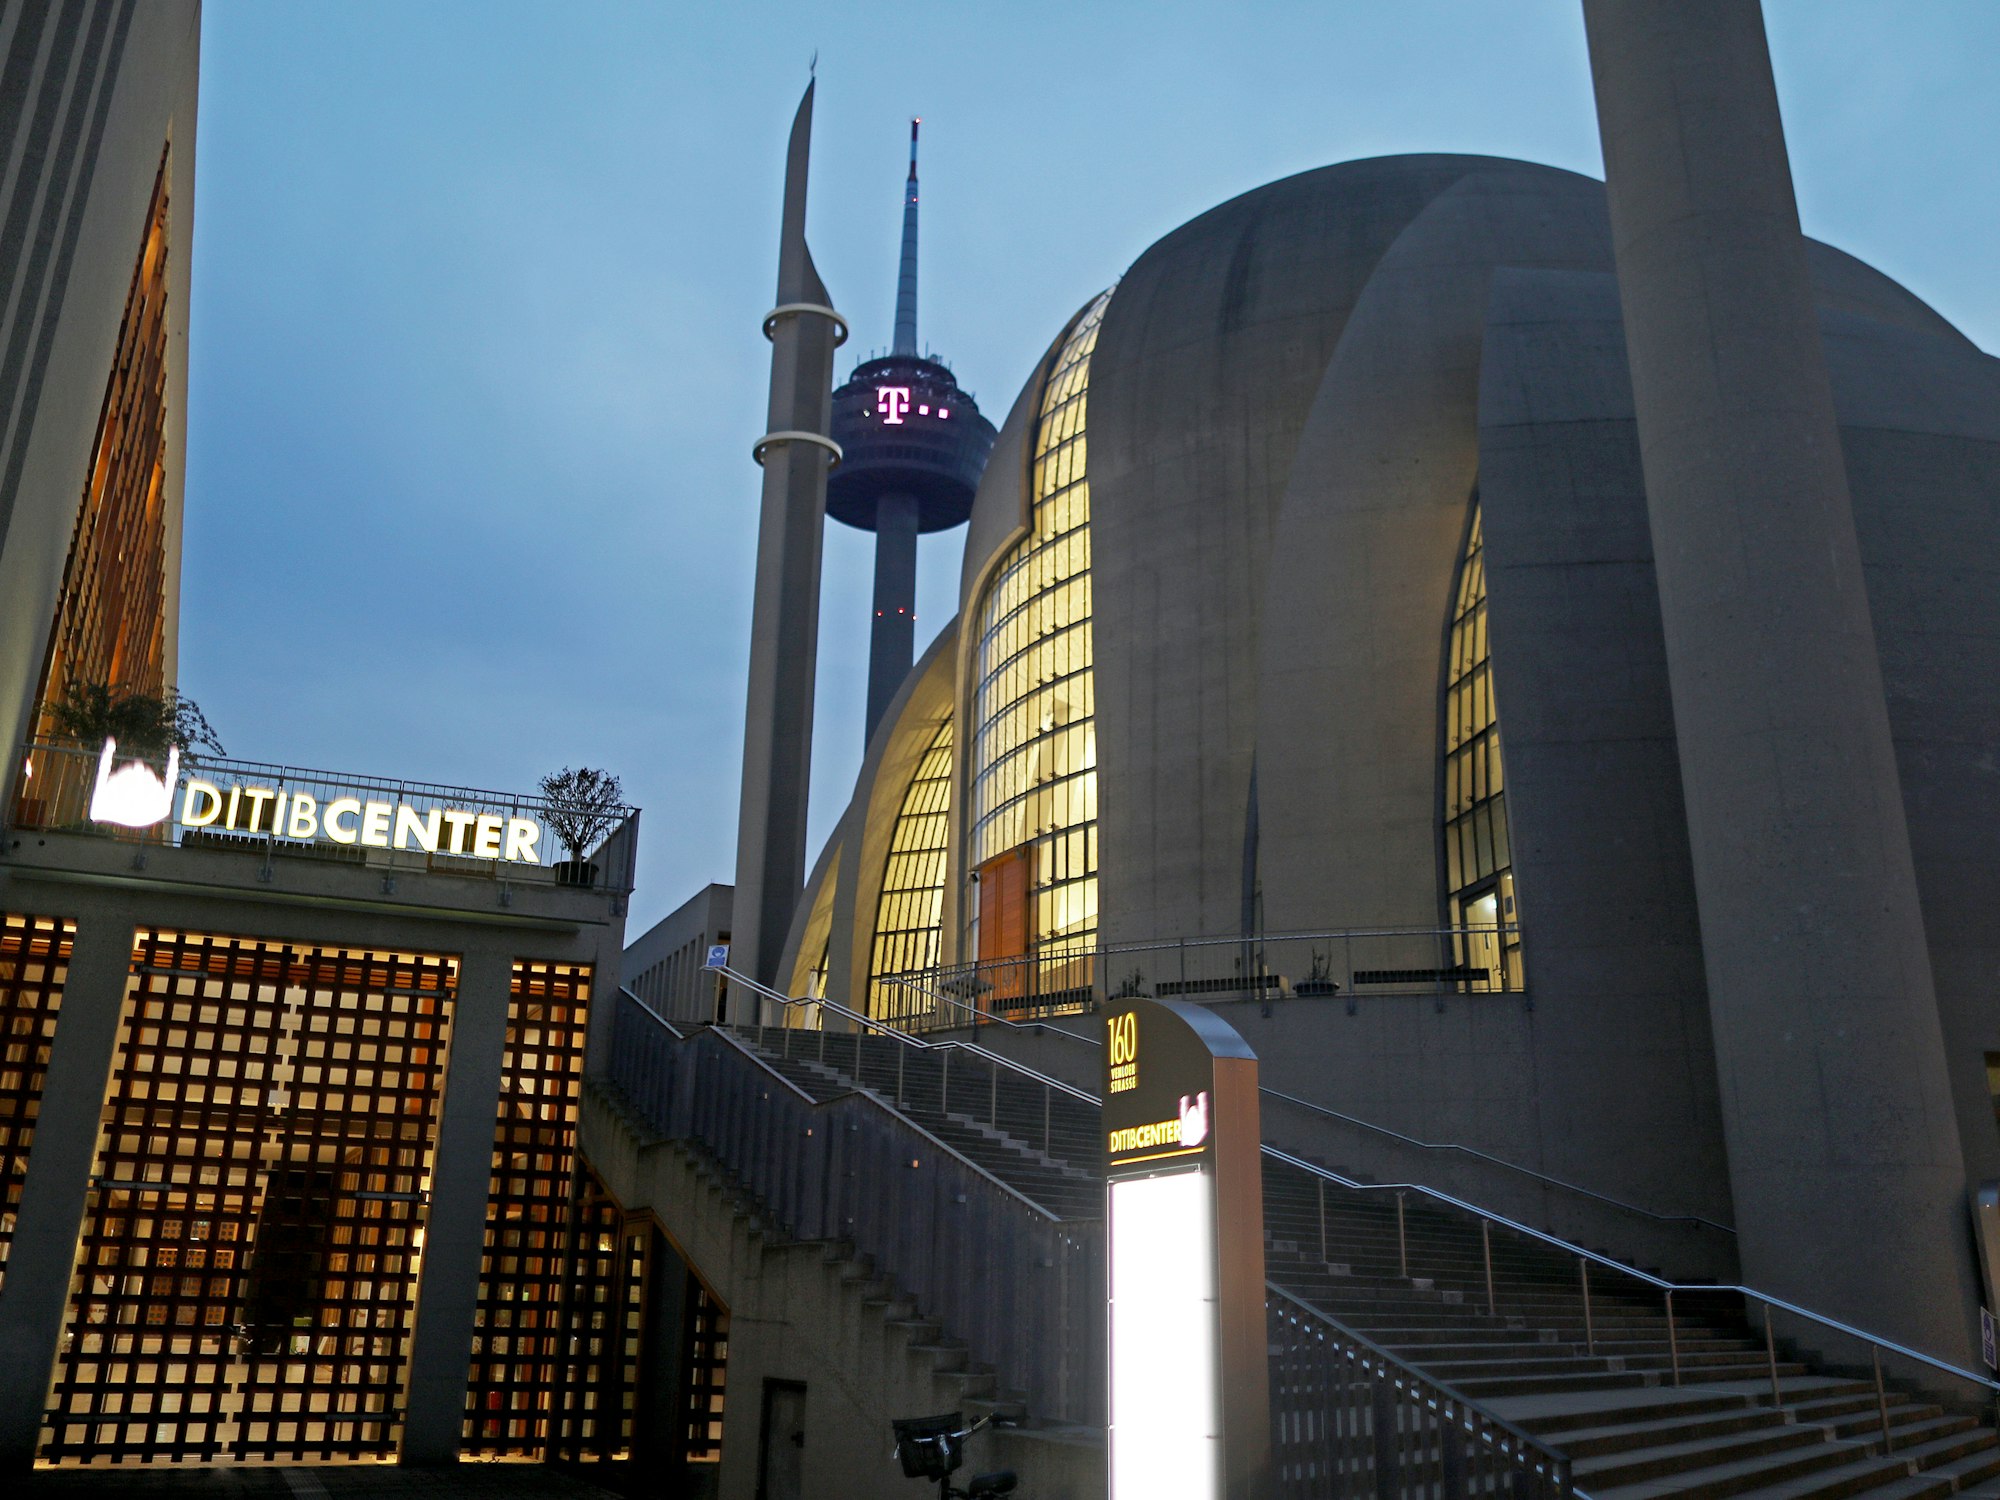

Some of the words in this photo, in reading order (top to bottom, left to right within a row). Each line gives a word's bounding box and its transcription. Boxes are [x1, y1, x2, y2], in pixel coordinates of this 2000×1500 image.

[181, 781, 540, 863] DITIBCENTER
[1107, 1012, 1136, 1066] 160
[1110, 1063, 1136, 1080] VENLOER
[1110, 1076, 1136, 1094] STRASSE
[1110, 1119, 1182, 1153] DITIBCENTER
